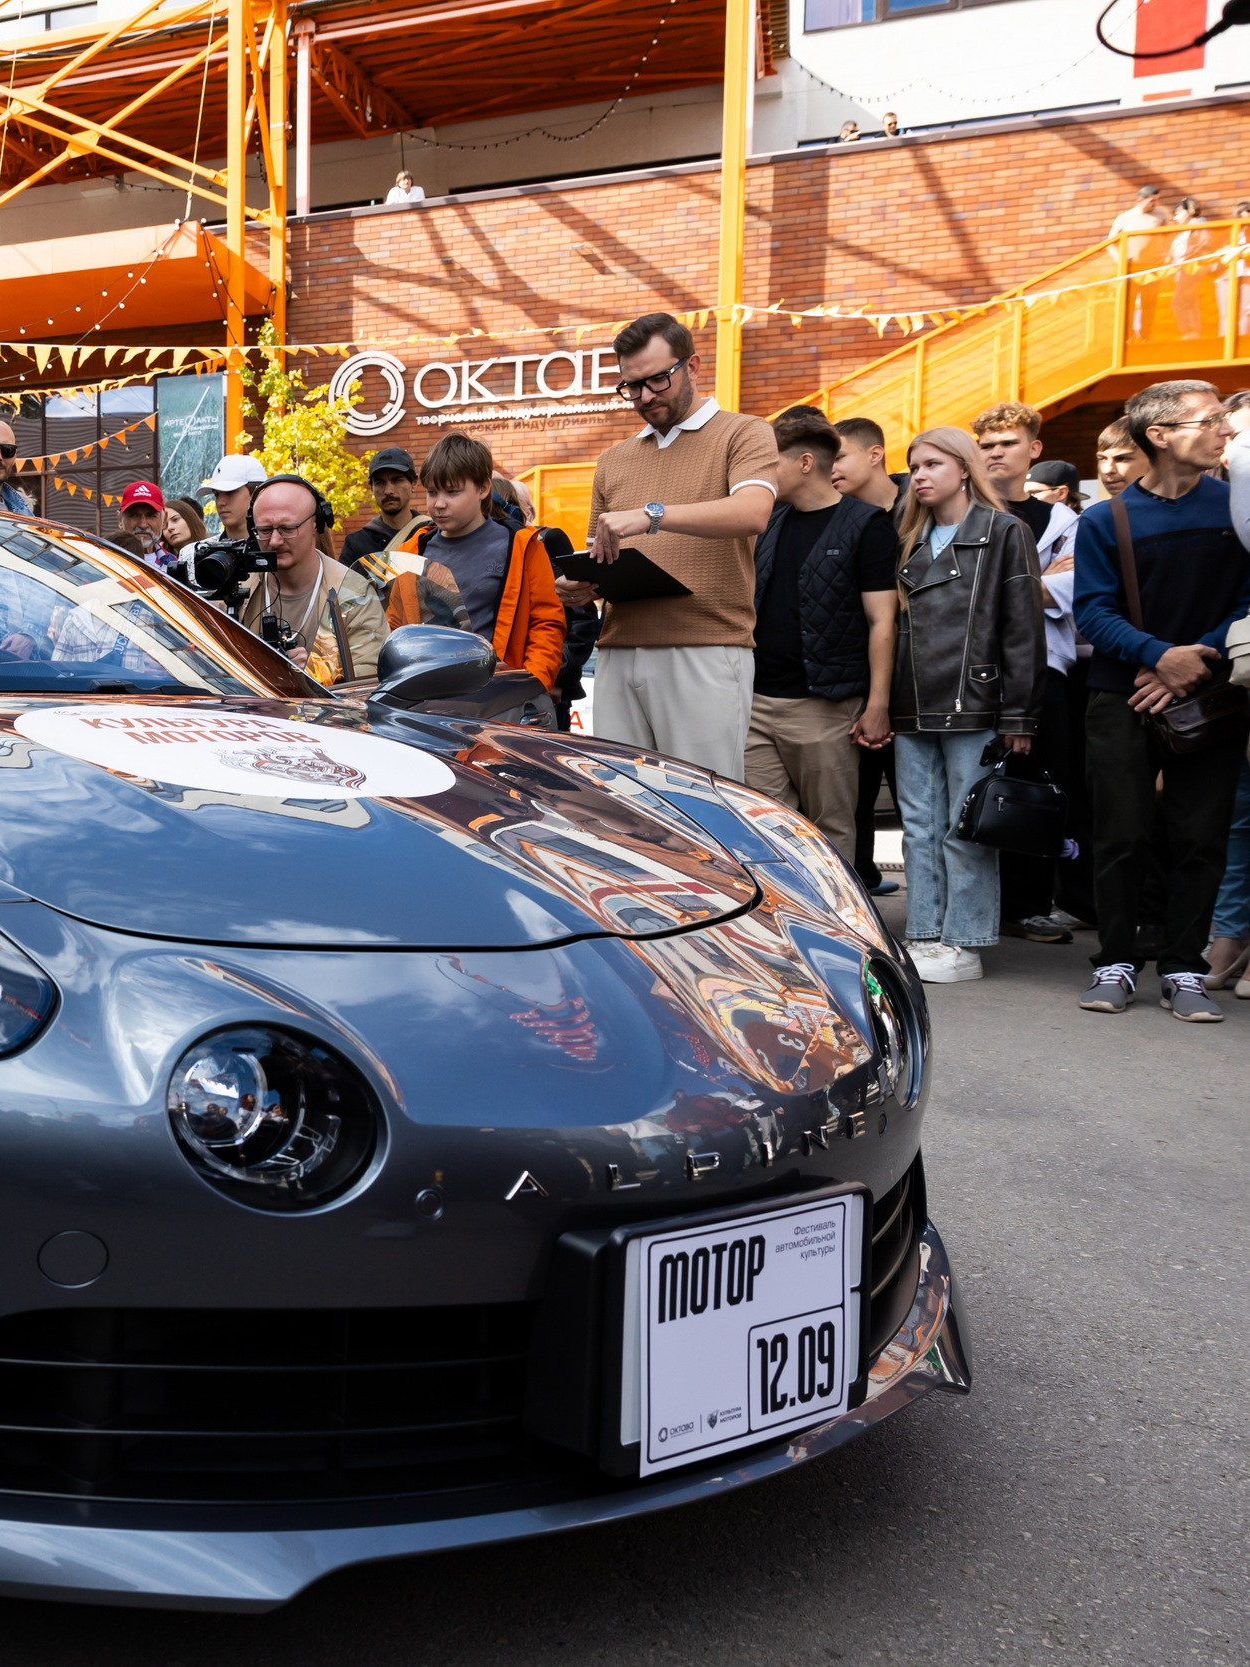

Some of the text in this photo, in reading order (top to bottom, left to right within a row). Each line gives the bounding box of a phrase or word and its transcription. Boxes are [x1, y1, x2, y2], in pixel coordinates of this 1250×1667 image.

[79, 717, 281, 730] КУЛЬТУРА
[124, 730, 321, 744] МОТОРОВ
[504, 1111, 866, 1200] ALPINE
[794, 1220, 836, 1236] Фестиваль
[775, 1231, 836, 1253] автомобильной
[800, 1244, 836, 1261] культуры
[658, 1234, 766, 1324] МОТОР
[756, 1321, 835, 1416] 12.09
[720, 1406, 742, 1416] КУЛЬТУРА
[720, 1413, 742, 1423] МОТОРОВ
